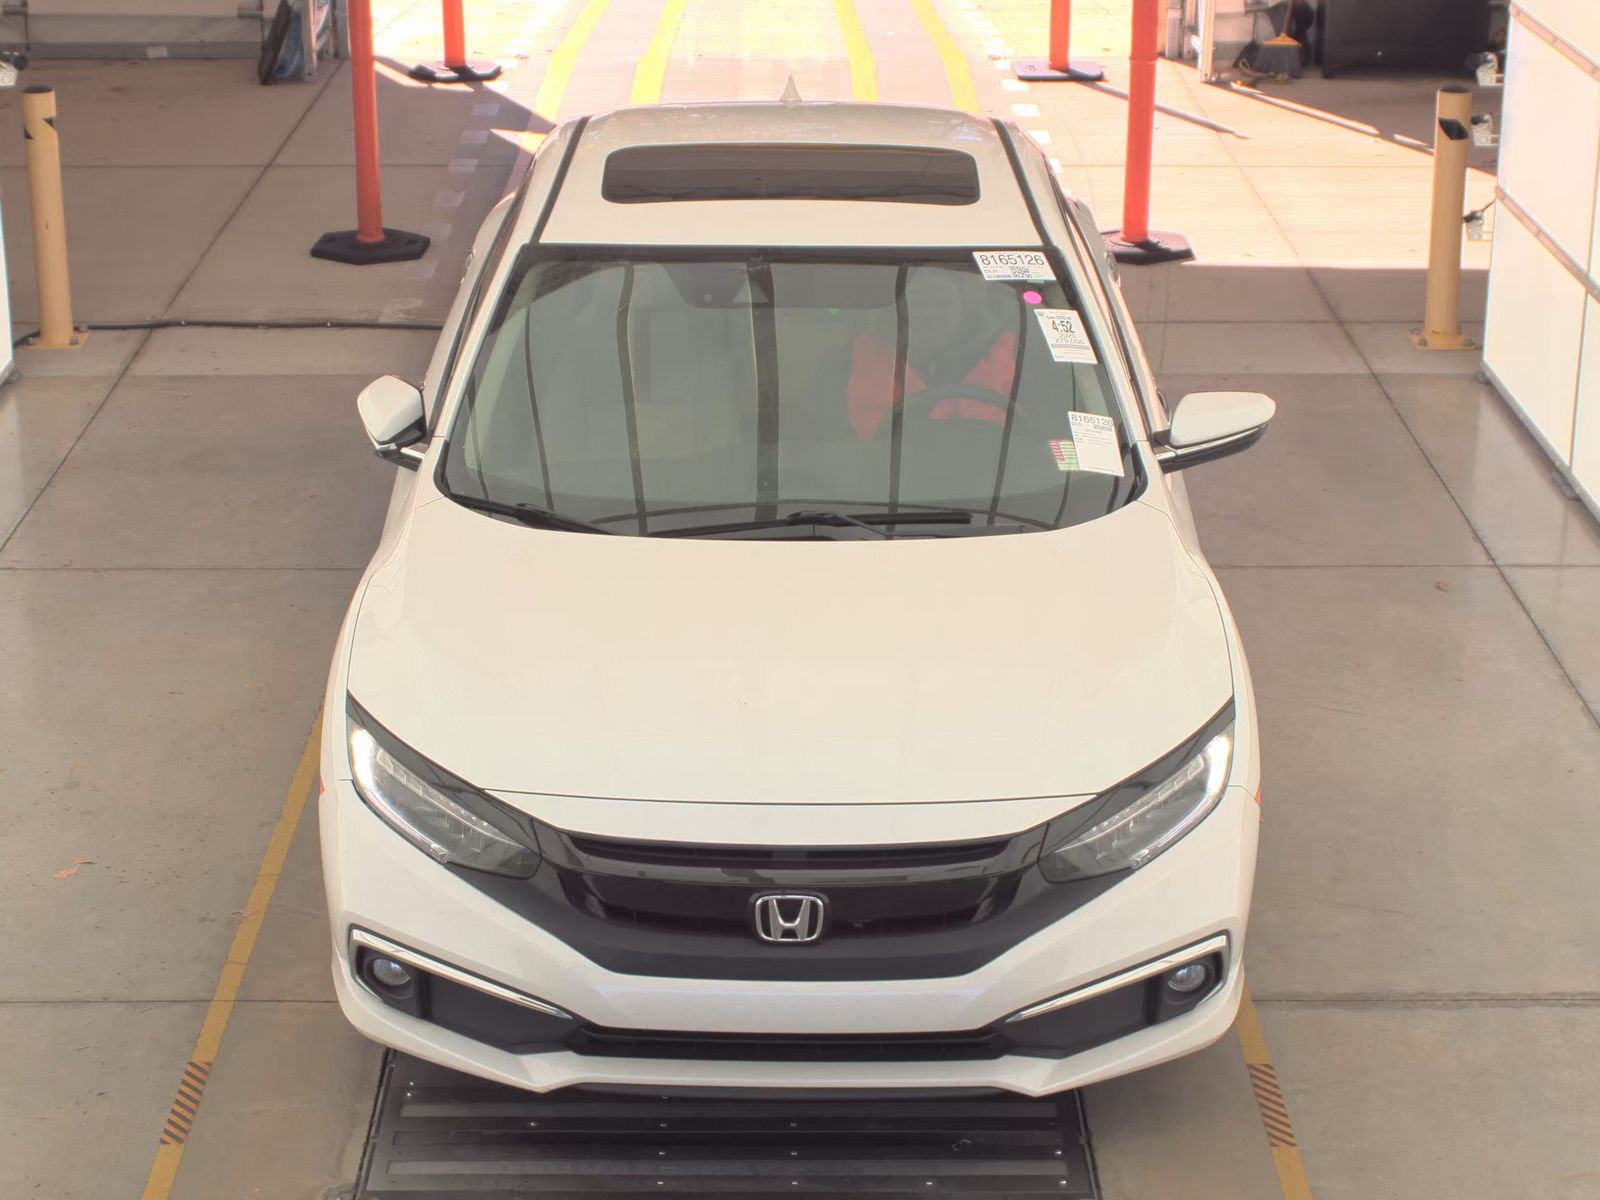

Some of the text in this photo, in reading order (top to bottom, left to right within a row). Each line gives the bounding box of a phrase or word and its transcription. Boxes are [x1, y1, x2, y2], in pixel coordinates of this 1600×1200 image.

[980, 254, 1045, 266] 8165126
[1052, 320, 1075, 333] 4:52
[1071, 413, 1114, 427] 8165126
